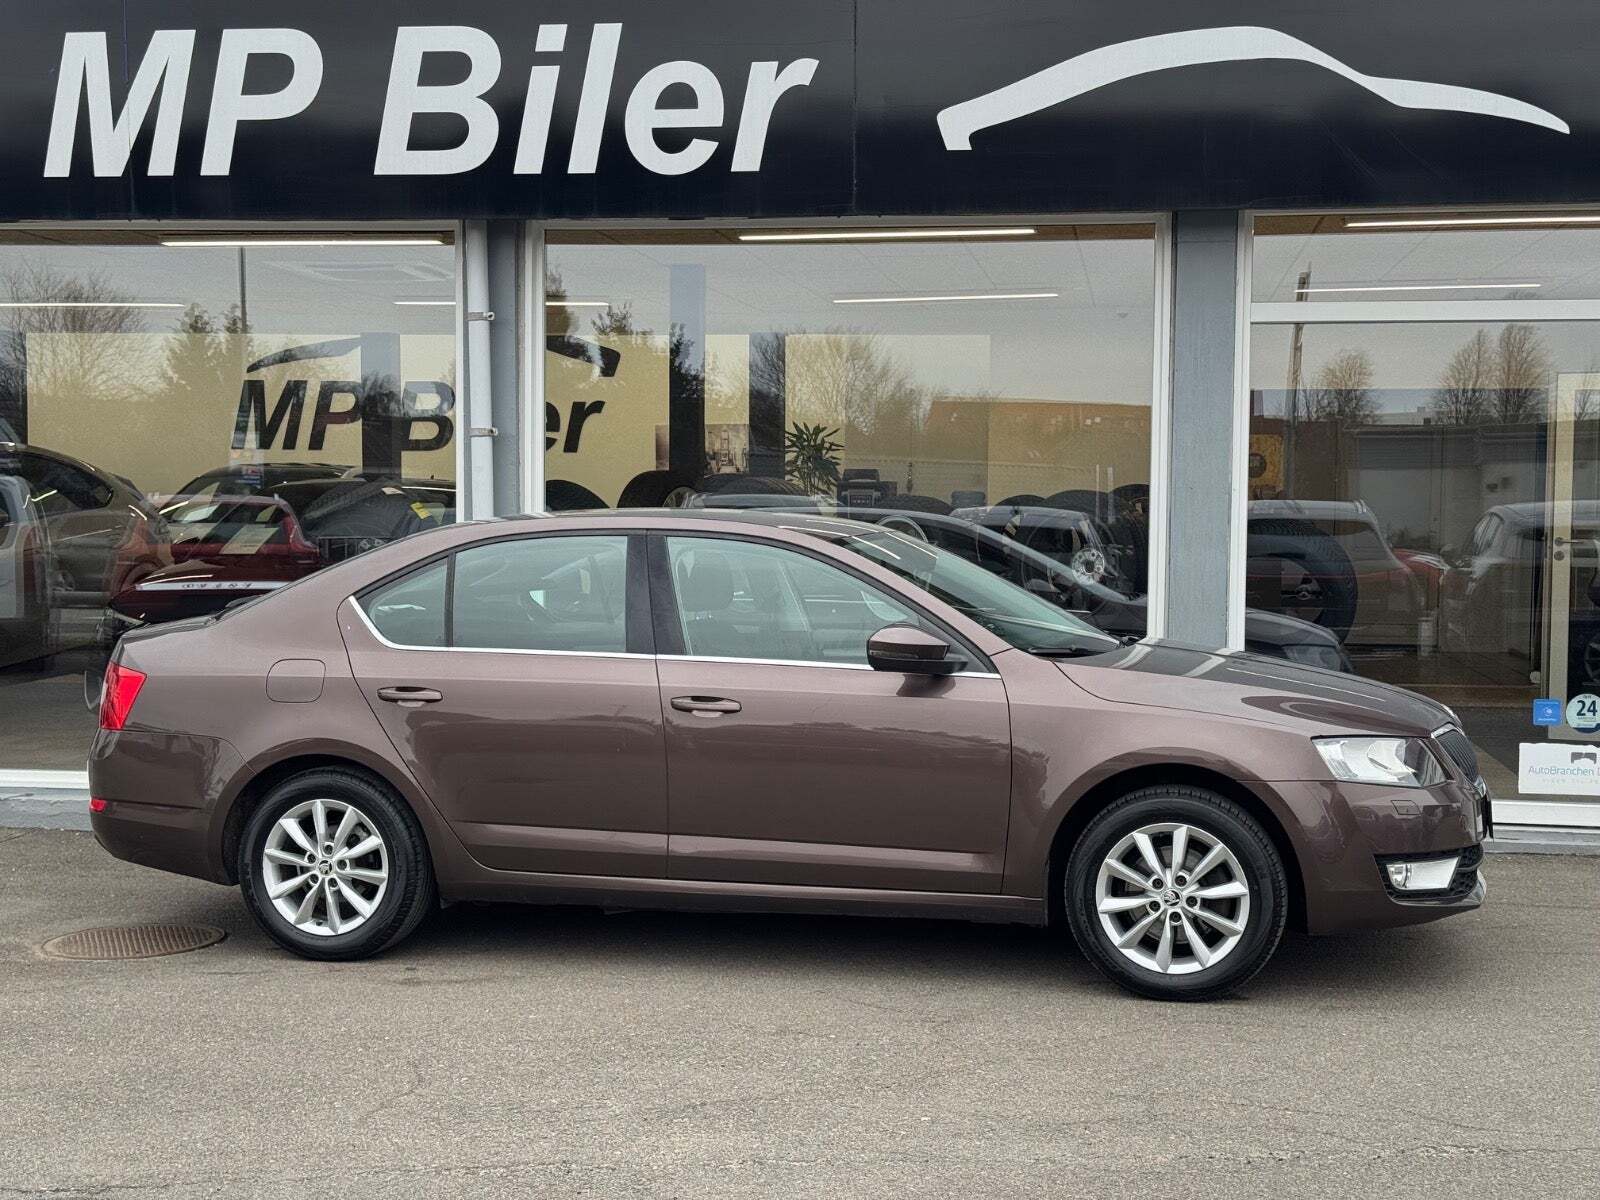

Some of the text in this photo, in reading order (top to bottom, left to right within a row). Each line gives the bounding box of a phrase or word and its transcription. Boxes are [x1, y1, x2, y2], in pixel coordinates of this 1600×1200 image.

[44, 23, 819, 177] MP Biler
[231, 380, 362, 450] MP
[1577, 700, 1597, 716] 24
[1528, 766, 1594, 776] AutoBranchen
